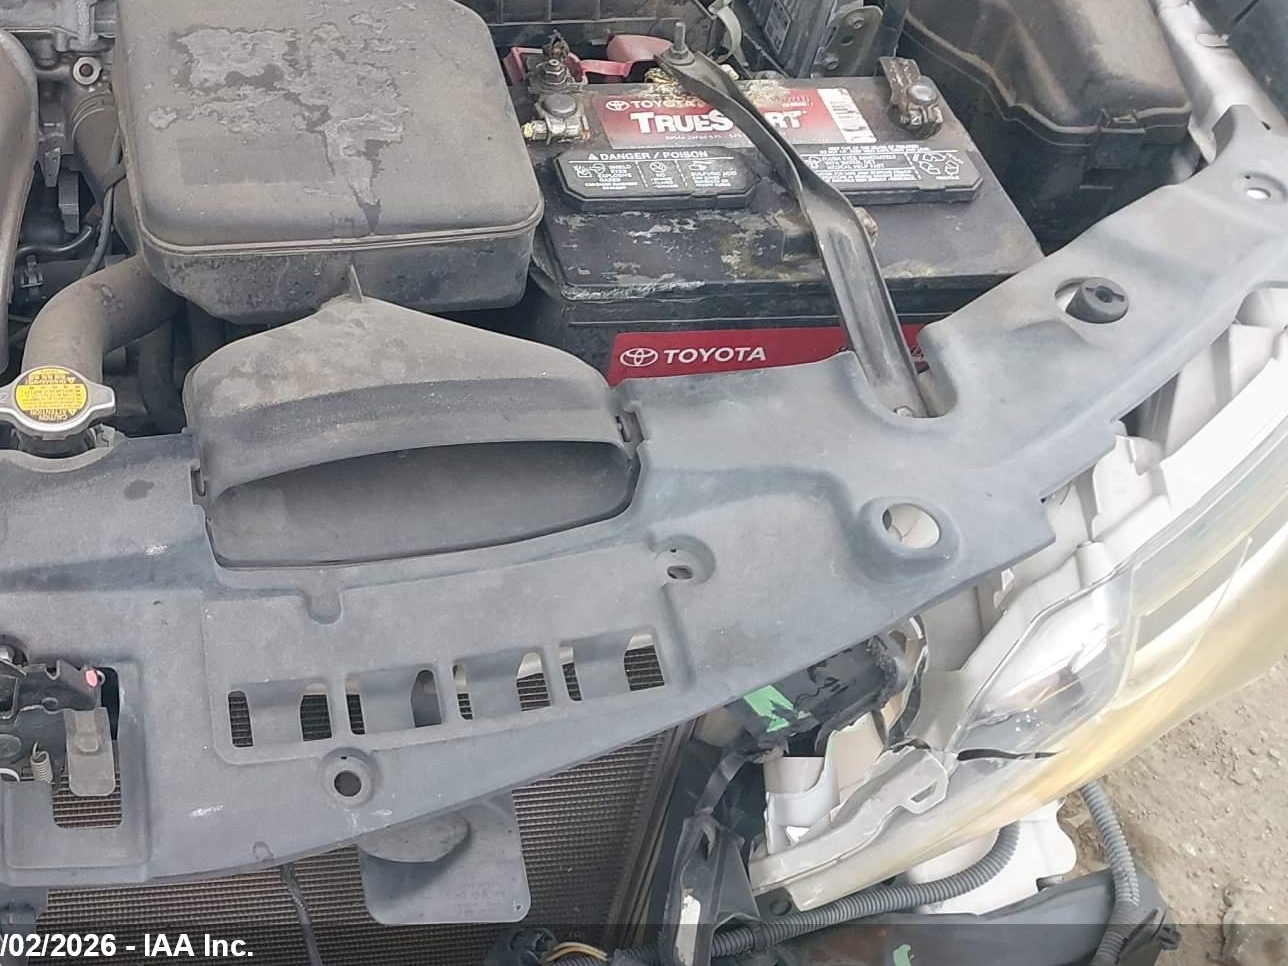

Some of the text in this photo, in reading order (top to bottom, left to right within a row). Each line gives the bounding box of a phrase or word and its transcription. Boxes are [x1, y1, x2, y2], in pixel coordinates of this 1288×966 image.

[630, 99, 698, 108] TOYOTA
[630, 109, 803, 133] TRUESRT
[599, 151, 651, 161] DANGER
[663, 150, 709, 159] POISON
[664, 347, 766, 364] TOYOTA
